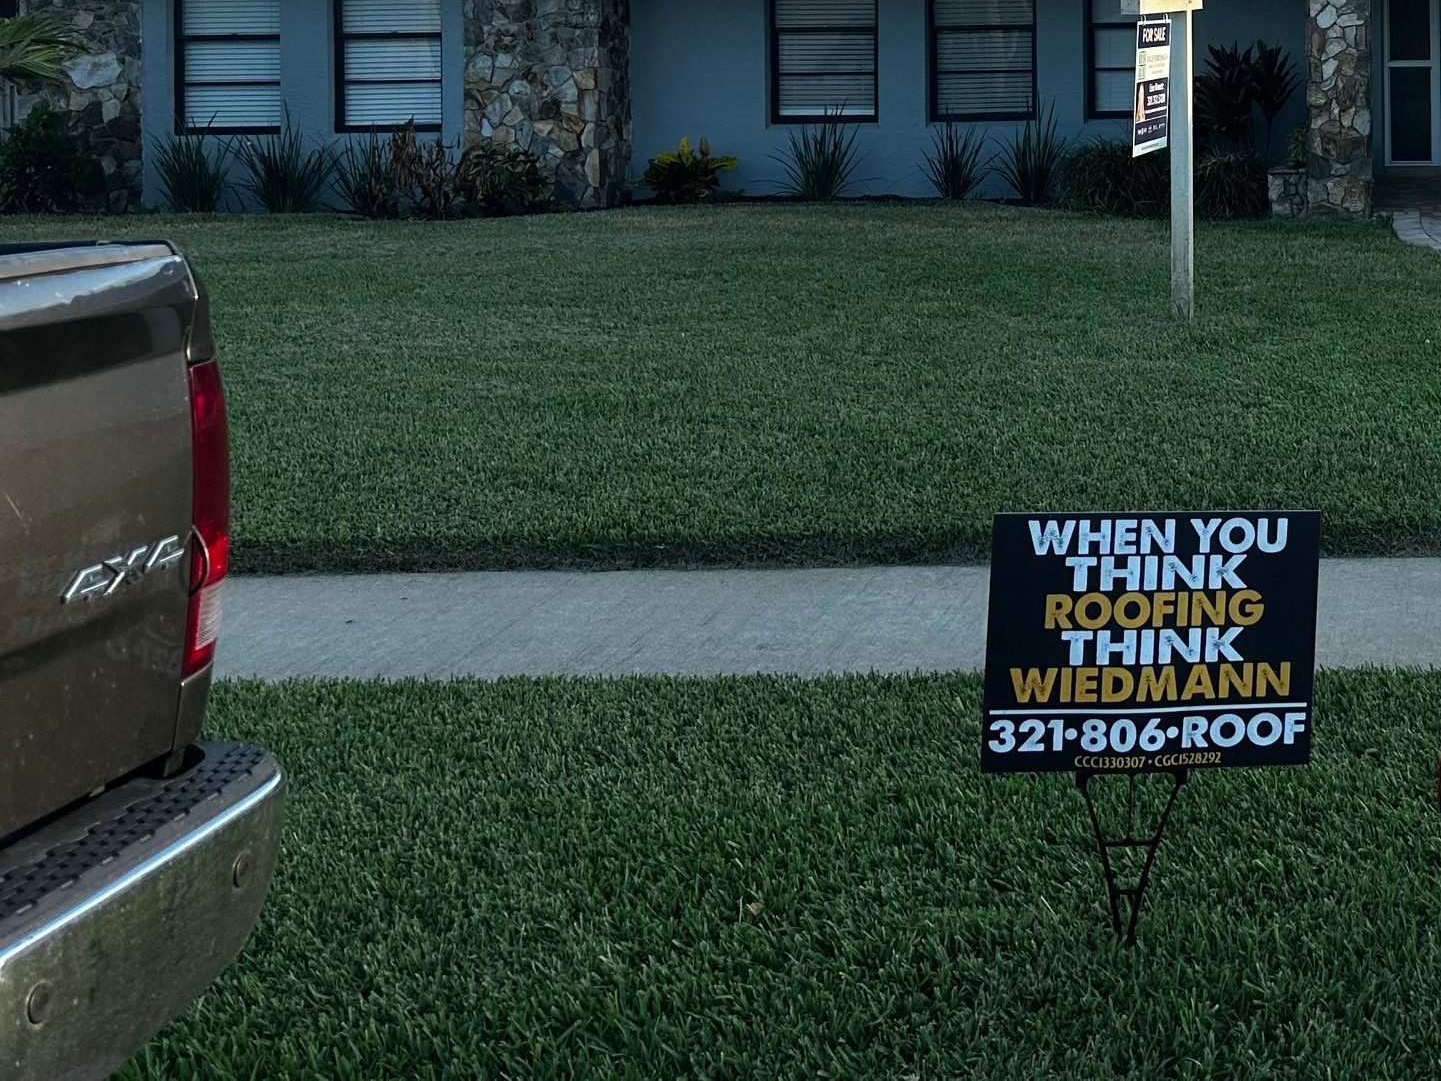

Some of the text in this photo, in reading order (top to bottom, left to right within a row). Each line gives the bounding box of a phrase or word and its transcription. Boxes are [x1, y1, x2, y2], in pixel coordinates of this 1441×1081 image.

[1142, 27, 1166, 42] FOR SALE
[1028, 517, 1289, 555] WHEN YOU
[1065, 554, 1248, 592] THINK
[1044, 589, 1265, 630] ROOFING
[1060, 626, 1245, 666] THINK
[1009, 662, 1291, 703] WIEDMANN
